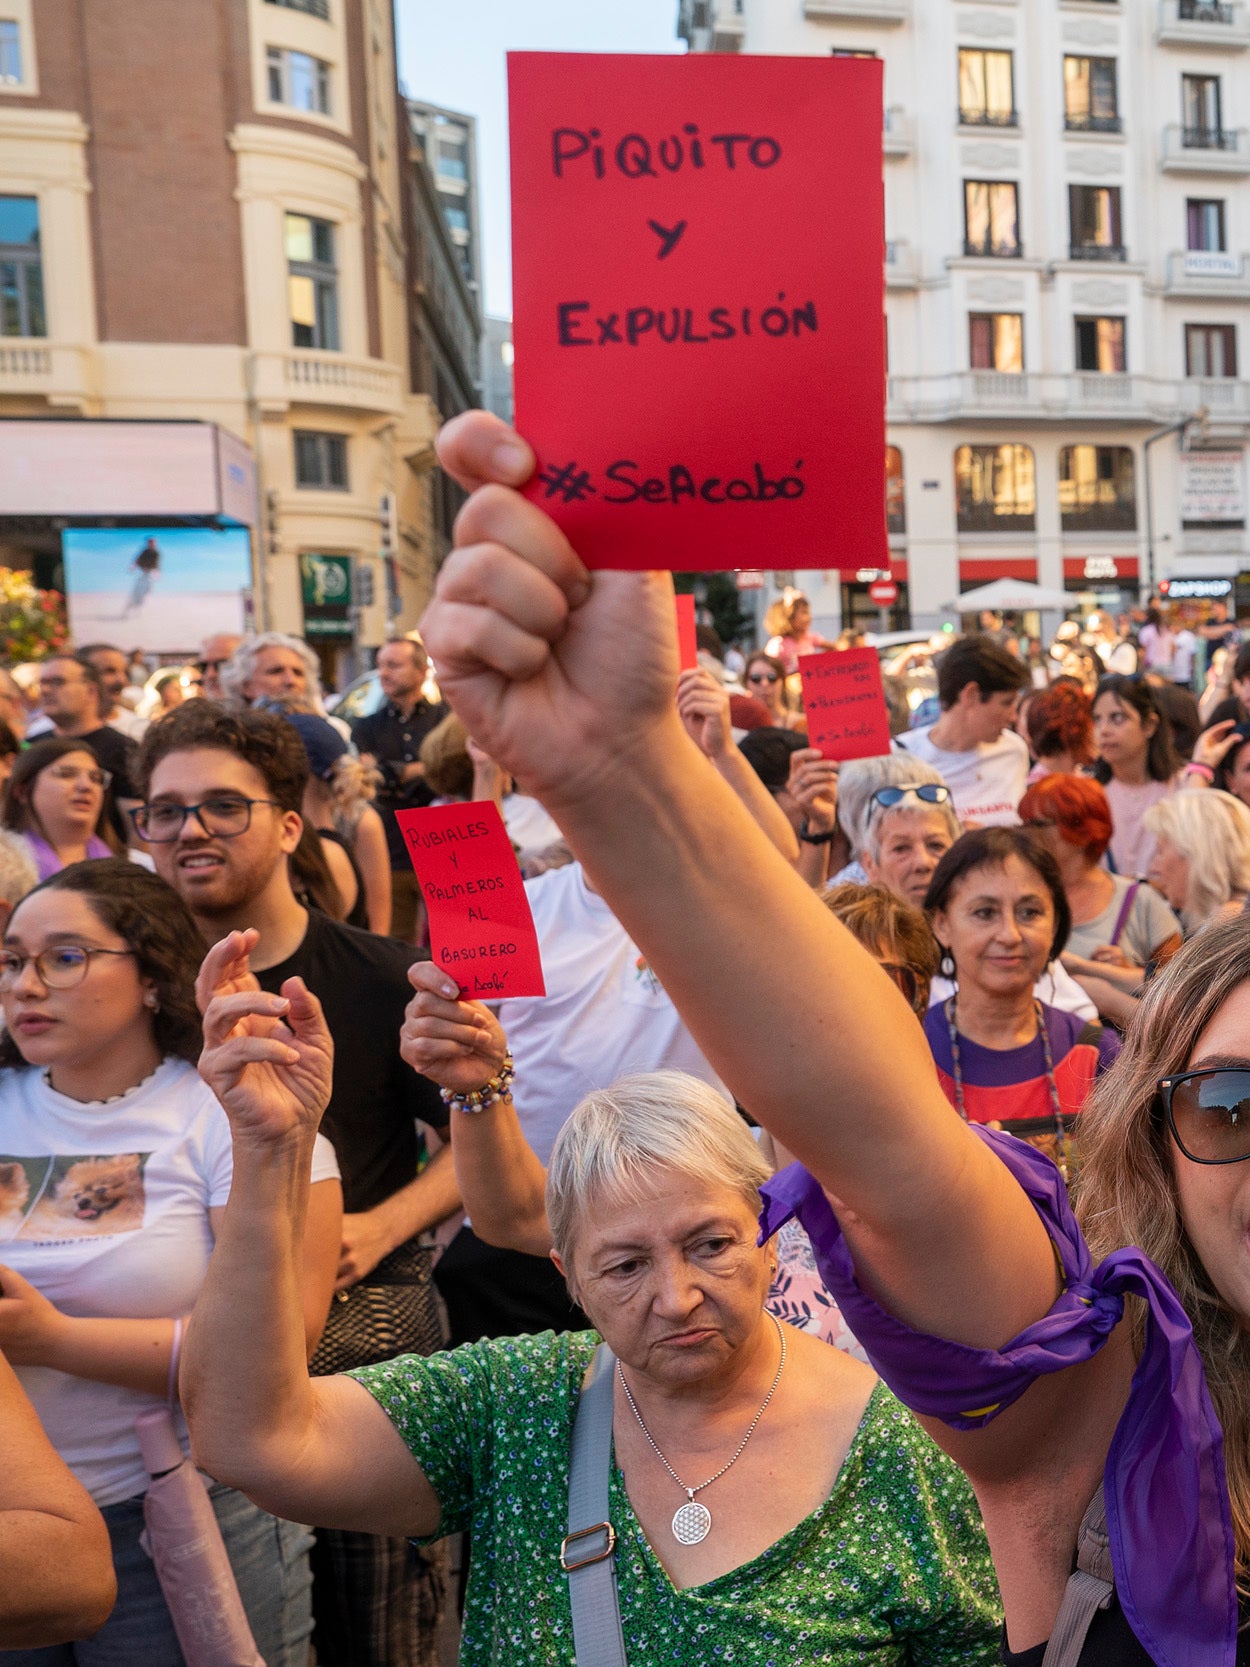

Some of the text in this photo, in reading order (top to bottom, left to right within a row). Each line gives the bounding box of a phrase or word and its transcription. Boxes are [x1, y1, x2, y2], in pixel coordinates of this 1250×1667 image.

[407, 821, 490, 849] RUBIALES
[449, 851, 459, 869] Y
[424, 877, 504, 900] PALMEROS
[468, 907, 489, 922] AL
[441, 943, 517, 963] BASURERO
